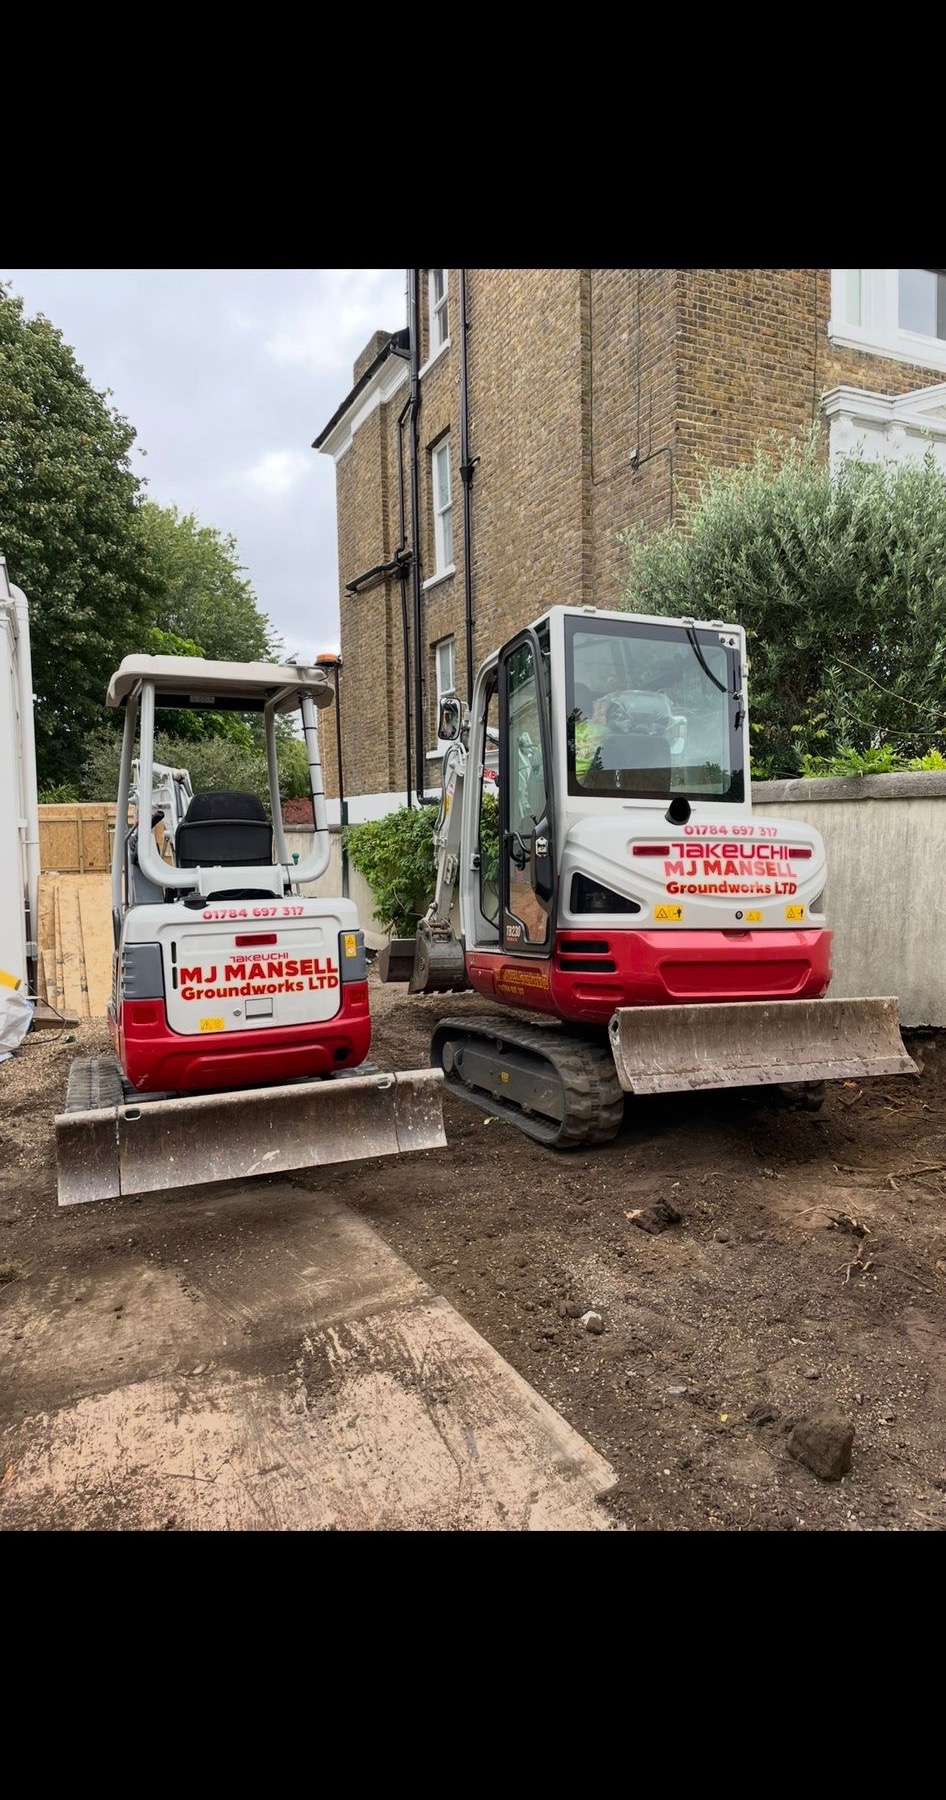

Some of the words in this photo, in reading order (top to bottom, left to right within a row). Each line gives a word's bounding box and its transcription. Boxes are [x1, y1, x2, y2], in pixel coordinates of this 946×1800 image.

[684, 825, 728, 836] 01784
[732, 825, 754, 836] 697
[759, 826, 778, 837] 317
[664, 861, 698, 876] MJ
[703, 861, 797, 878] MANSELL
[666, 881, 771, 895] Groundworks
[775, 882, 797, 895] LTD
[203, 908, 248, 920] 01784
[252, 907, 277, 917] 697
[283, 906, 304, 916] 317
[180, 965, 217, 985] MJ
[224, 958, 338, 982] MANSELL
[181, 979, 304, 1001] Groundworks
[308, 975, 339, 990] LTD
